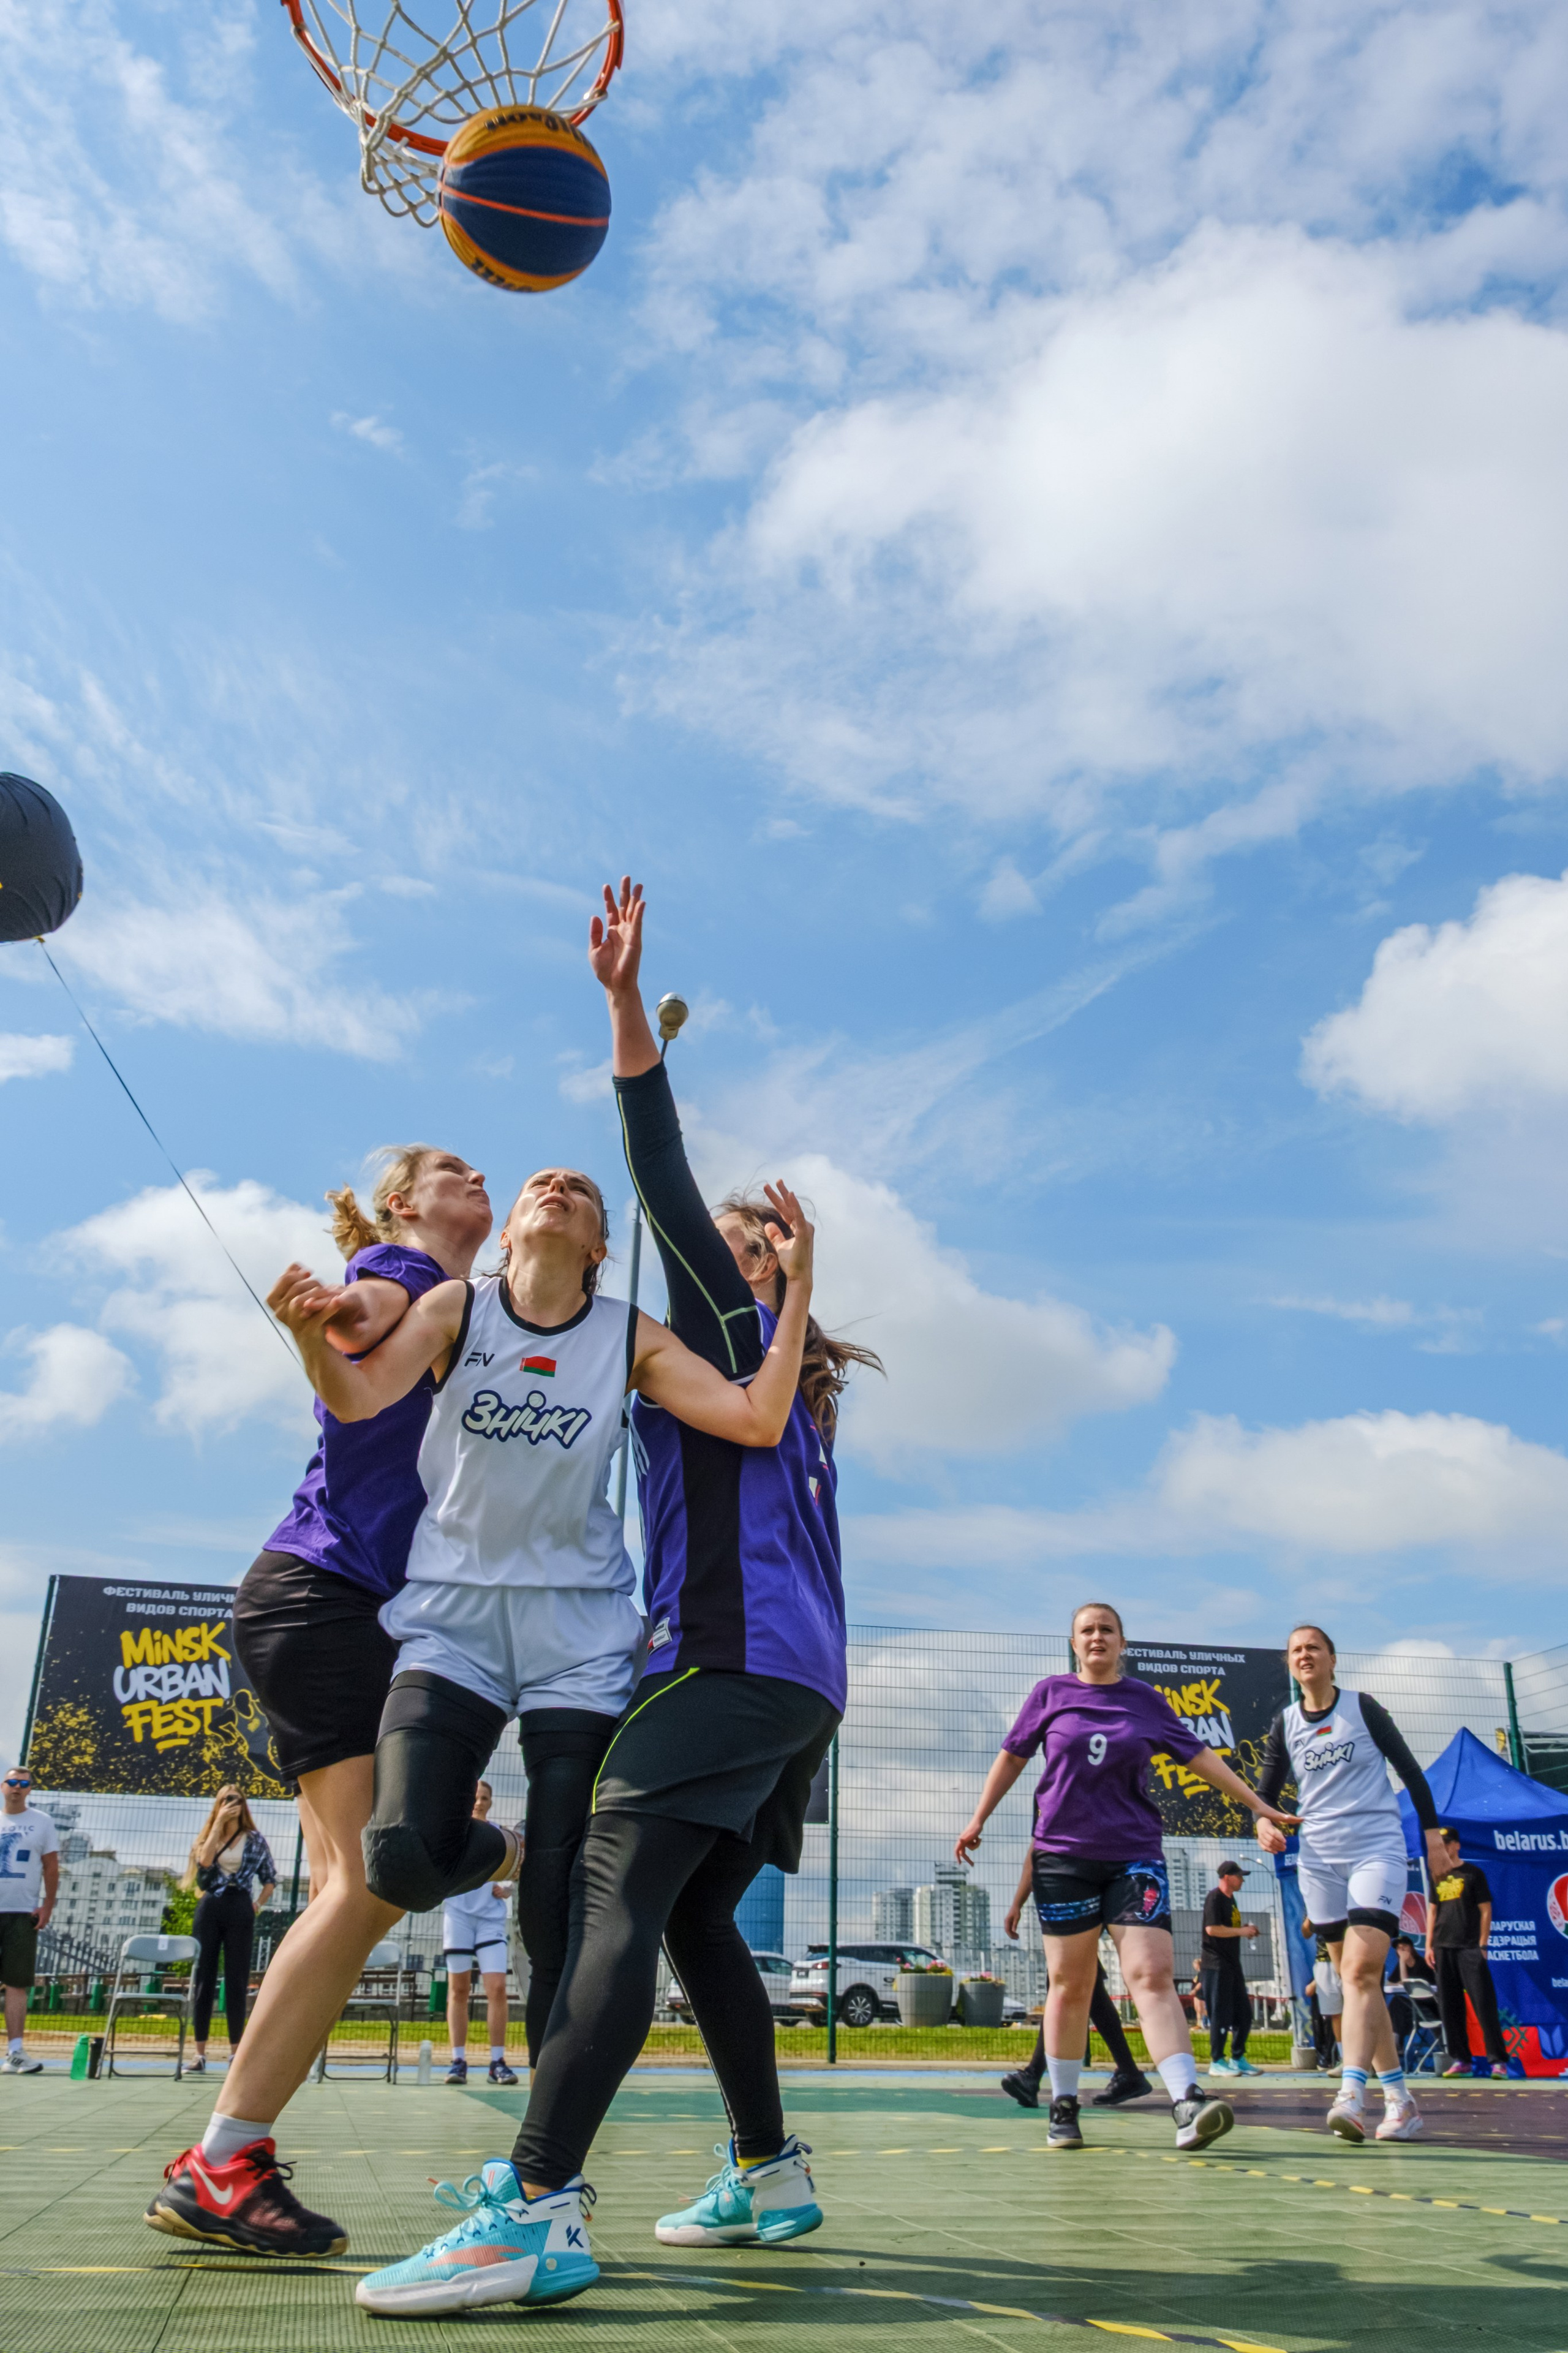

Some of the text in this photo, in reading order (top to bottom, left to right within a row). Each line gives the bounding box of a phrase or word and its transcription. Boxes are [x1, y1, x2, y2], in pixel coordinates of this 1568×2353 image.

[103, 1585, 190, 1601] ФЕСТИВАЛЬ
[126, 1602, 233, 1618] ВИДОВ СПОРТА
[1189, 1651, 1246, 1663] УЛИЧНЫХ
[1137, 1661, 1226, 1676] ВИДОВ СПОРТА
[113, 1656, 231, 1704] URBAN
[121, 1698, 224, 1743] FEST
[1087, 1733, 1107, 1766] 9
